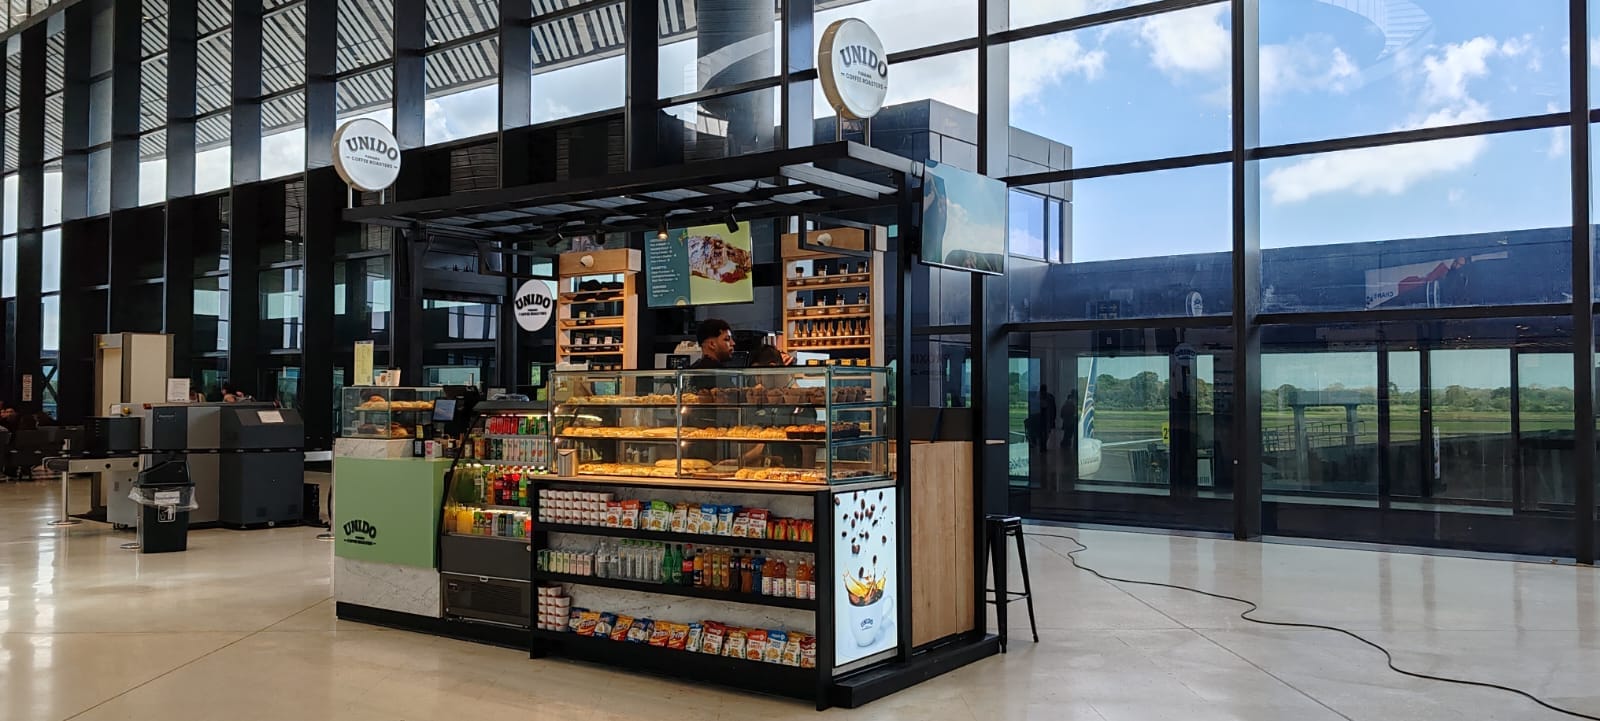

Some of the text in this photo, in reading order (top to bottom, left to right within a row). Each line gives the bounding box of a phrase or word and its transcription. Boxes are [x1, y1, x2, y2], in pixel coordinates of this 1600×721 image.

[840, 45, 887, 77] UNIDO
[345, 136, 398, 160] UNIDO
[516, 294, 550, 310] UNIDO
[343, 520, 377, 539] UNIDO
